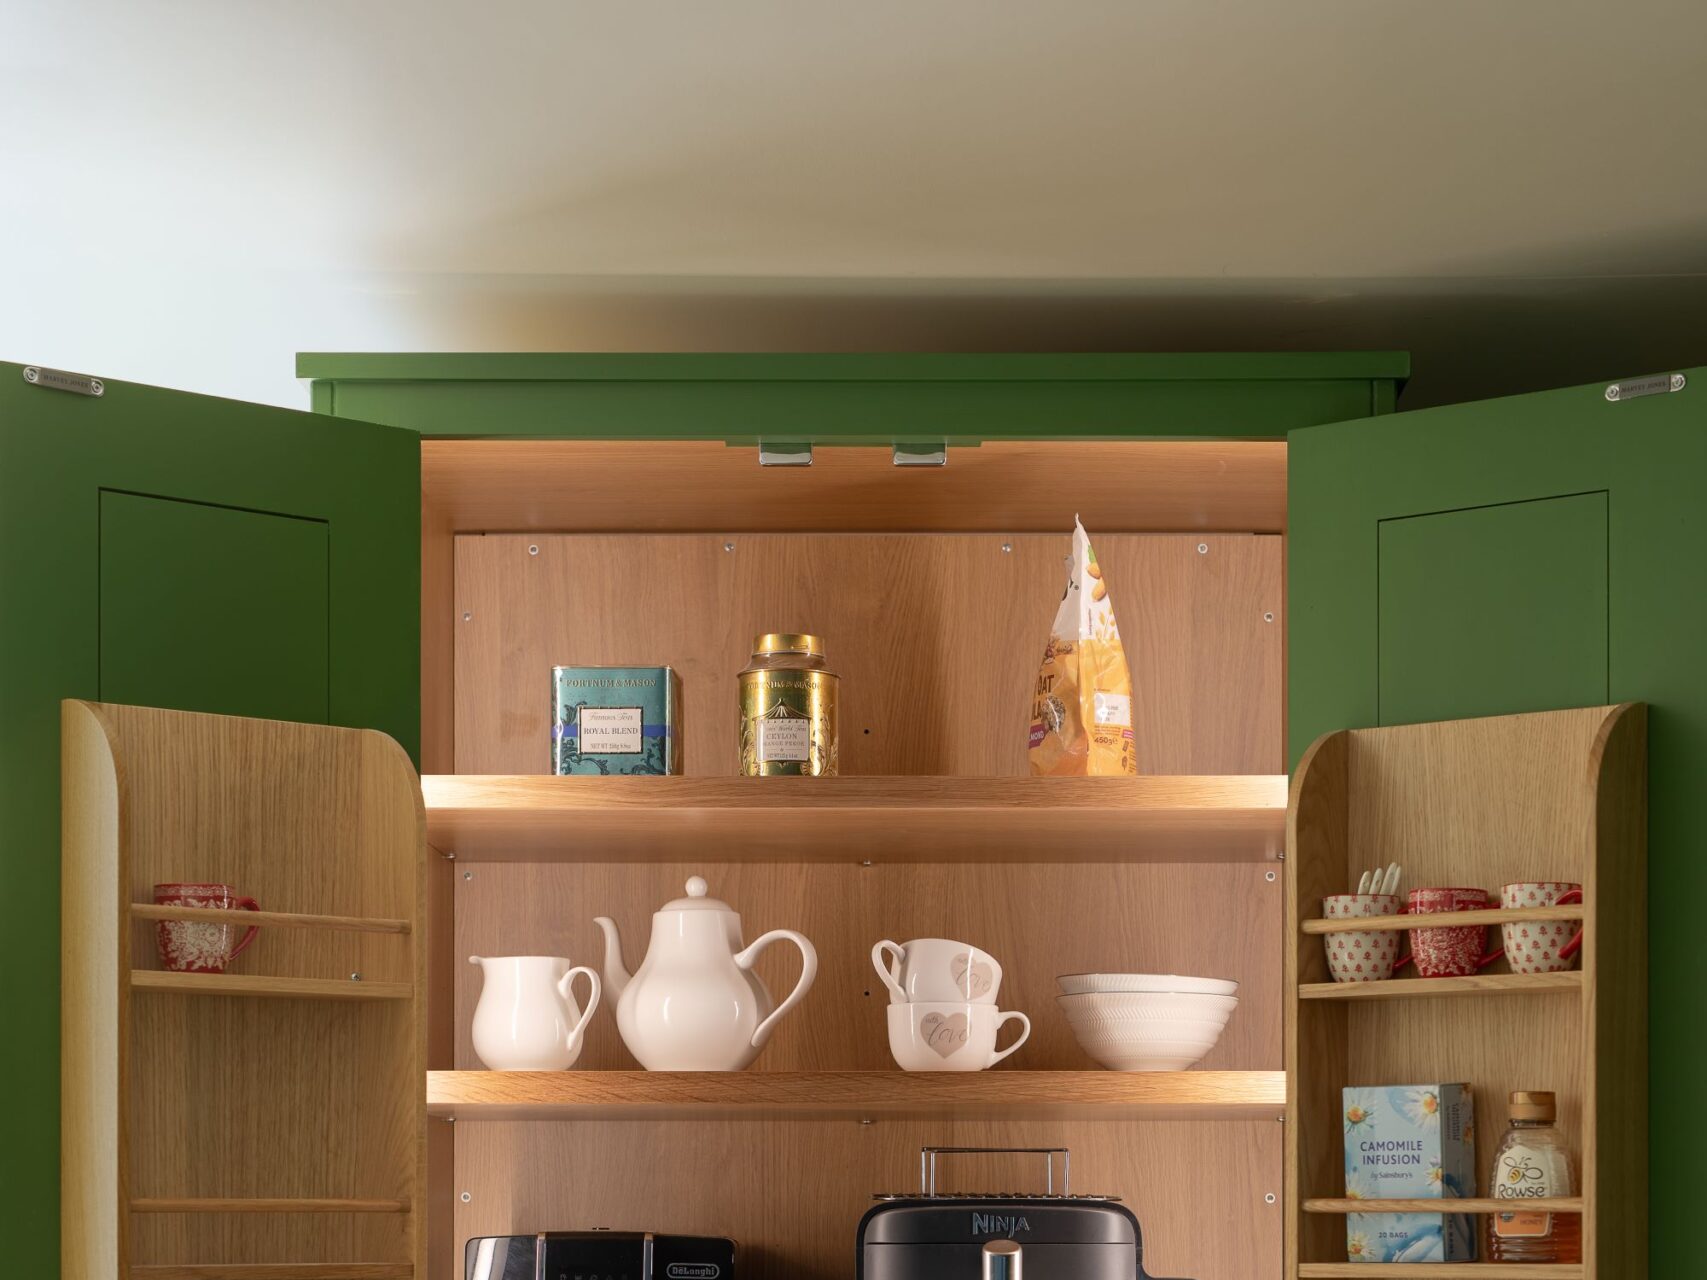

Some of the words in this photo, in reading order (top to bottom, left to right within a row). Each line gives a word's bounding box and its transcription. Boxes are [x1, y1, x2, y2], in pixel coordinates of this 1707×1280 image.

[566, 679, 614, 688] FORTNUM
[615, 679, 622, 688] &
[623, 679, 657, 688] MASON
[583, 727, 610, 735] ROYAL
[611, 727, 639, 735] BLEND
[766, 732, 798, 740] CEYLON
[1360, 1140, 1423, 1152] CAMOMILE
[1362, 1153, 1421, 1166] INFUSION
[1370, 1170, 1379, 1181] by
[1379, 1170, 1413, 1180] Sainsbury's
[1498, 1183, 1546, 1200] Rowse
[972, 1212, 1030, 1239] NINJA
[1378, 1231, 1388, 1239] 20
[1389, 1231, 1409, 1239] BAGS
